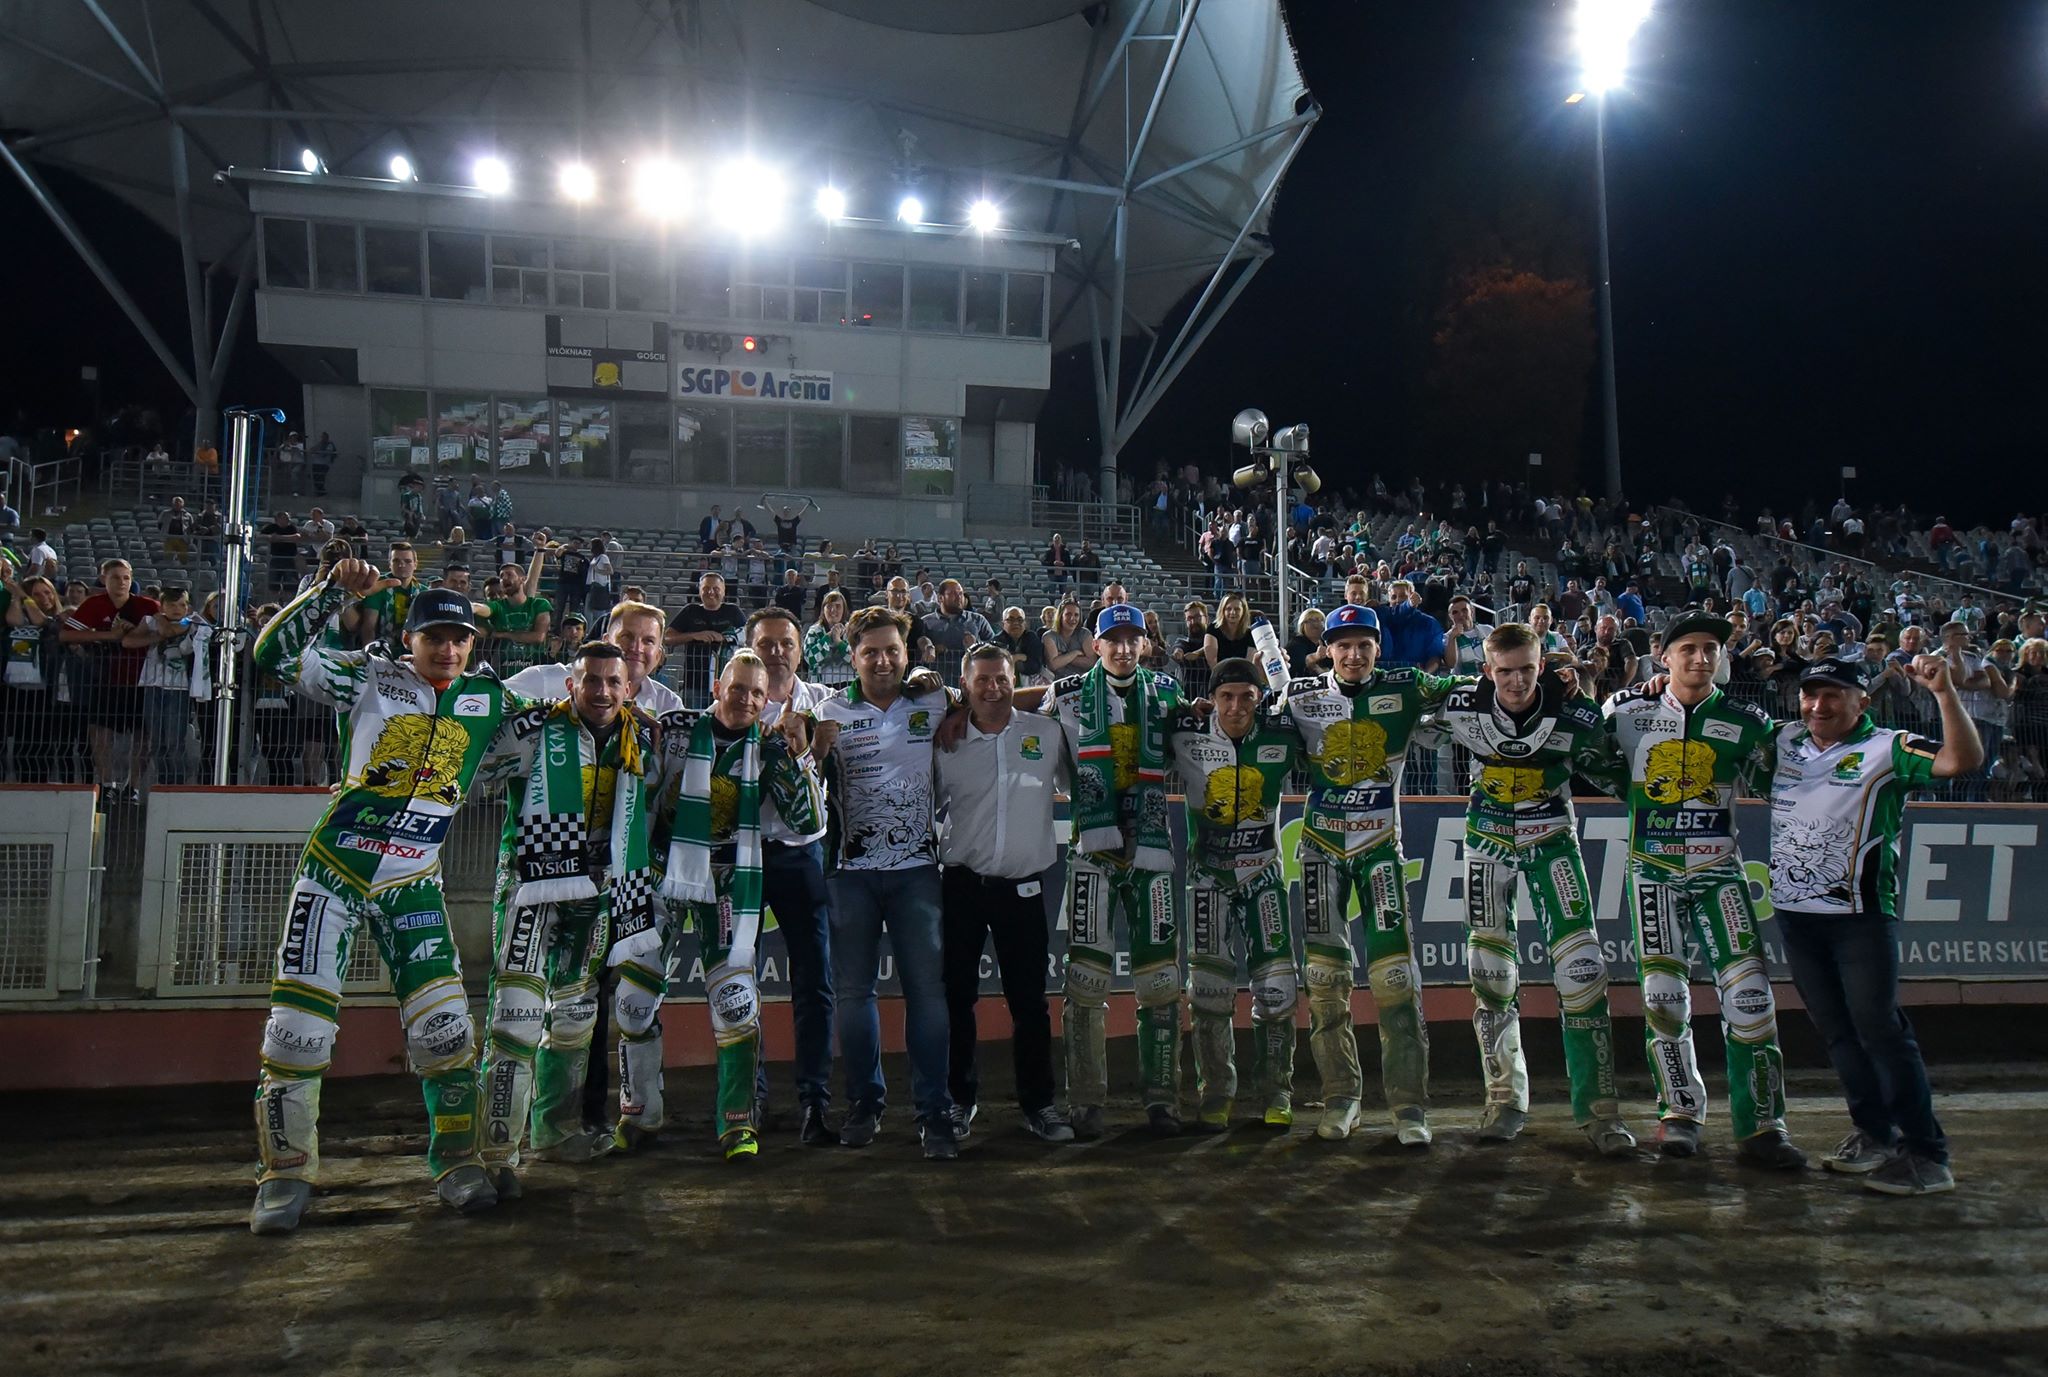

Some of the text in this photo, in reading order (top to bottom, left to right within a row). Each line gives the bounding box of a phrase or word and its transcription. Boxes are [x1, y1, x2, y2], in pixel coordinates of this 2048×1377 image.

[636, 350, 666, 362] GOŚCIE
[759, 371, 831, 401] Arena
[462, 704, 480, 713] PGE
[1376, 703, 1393, 711] PGE
[549, 723, 567, 767] CKM
[852, 734, 880, 743] TOYOTA
[1711, 728, 1730, 738] PGE
[1321, 788, 1381, 806] forBET
[354, 806, 440, 835] forBET
[1646, 810, 1720, 830] forBET
[526, 856, 581, 878] TYSKIE
[1555, 863, 1572, 899] CENTRUM
[1560, 860, 1579, 899] DAWID
[1156, 880, 1165, 920] CENTRUM
[1162, 877, 1173, 922] DAWID
[1372, 875, 1384, 928] OGRODNICZE
[1376, 867, 1387, 906] CENTRUM
[1383, 865, 1397, 909] DAWID
[1552, 871, 1571, 916] OGRODNICZE
[615, 911, 648, 940] TYSKIE
[1151, 887, 1159, 940] OGRODNICZE
[1269, 893, 1281, 932] DAWID
[1640, 886, 1660, 954] Koloryt
[1720, 898, 1739, 950] OGRODNICZE
[1724, 890, 1740, 928] CENTRUM
[1729, 887, 1749, 931] DAWID
[596, 915, 607, 956] DAWID
[501, 1008, 543, 1018] IMPAKT
[719, 993, 750, 1011] BASTEJA
[267, 1022, 326, 1048] IMPAKT
[425, 1021, 464, 1045] BASTEJA
